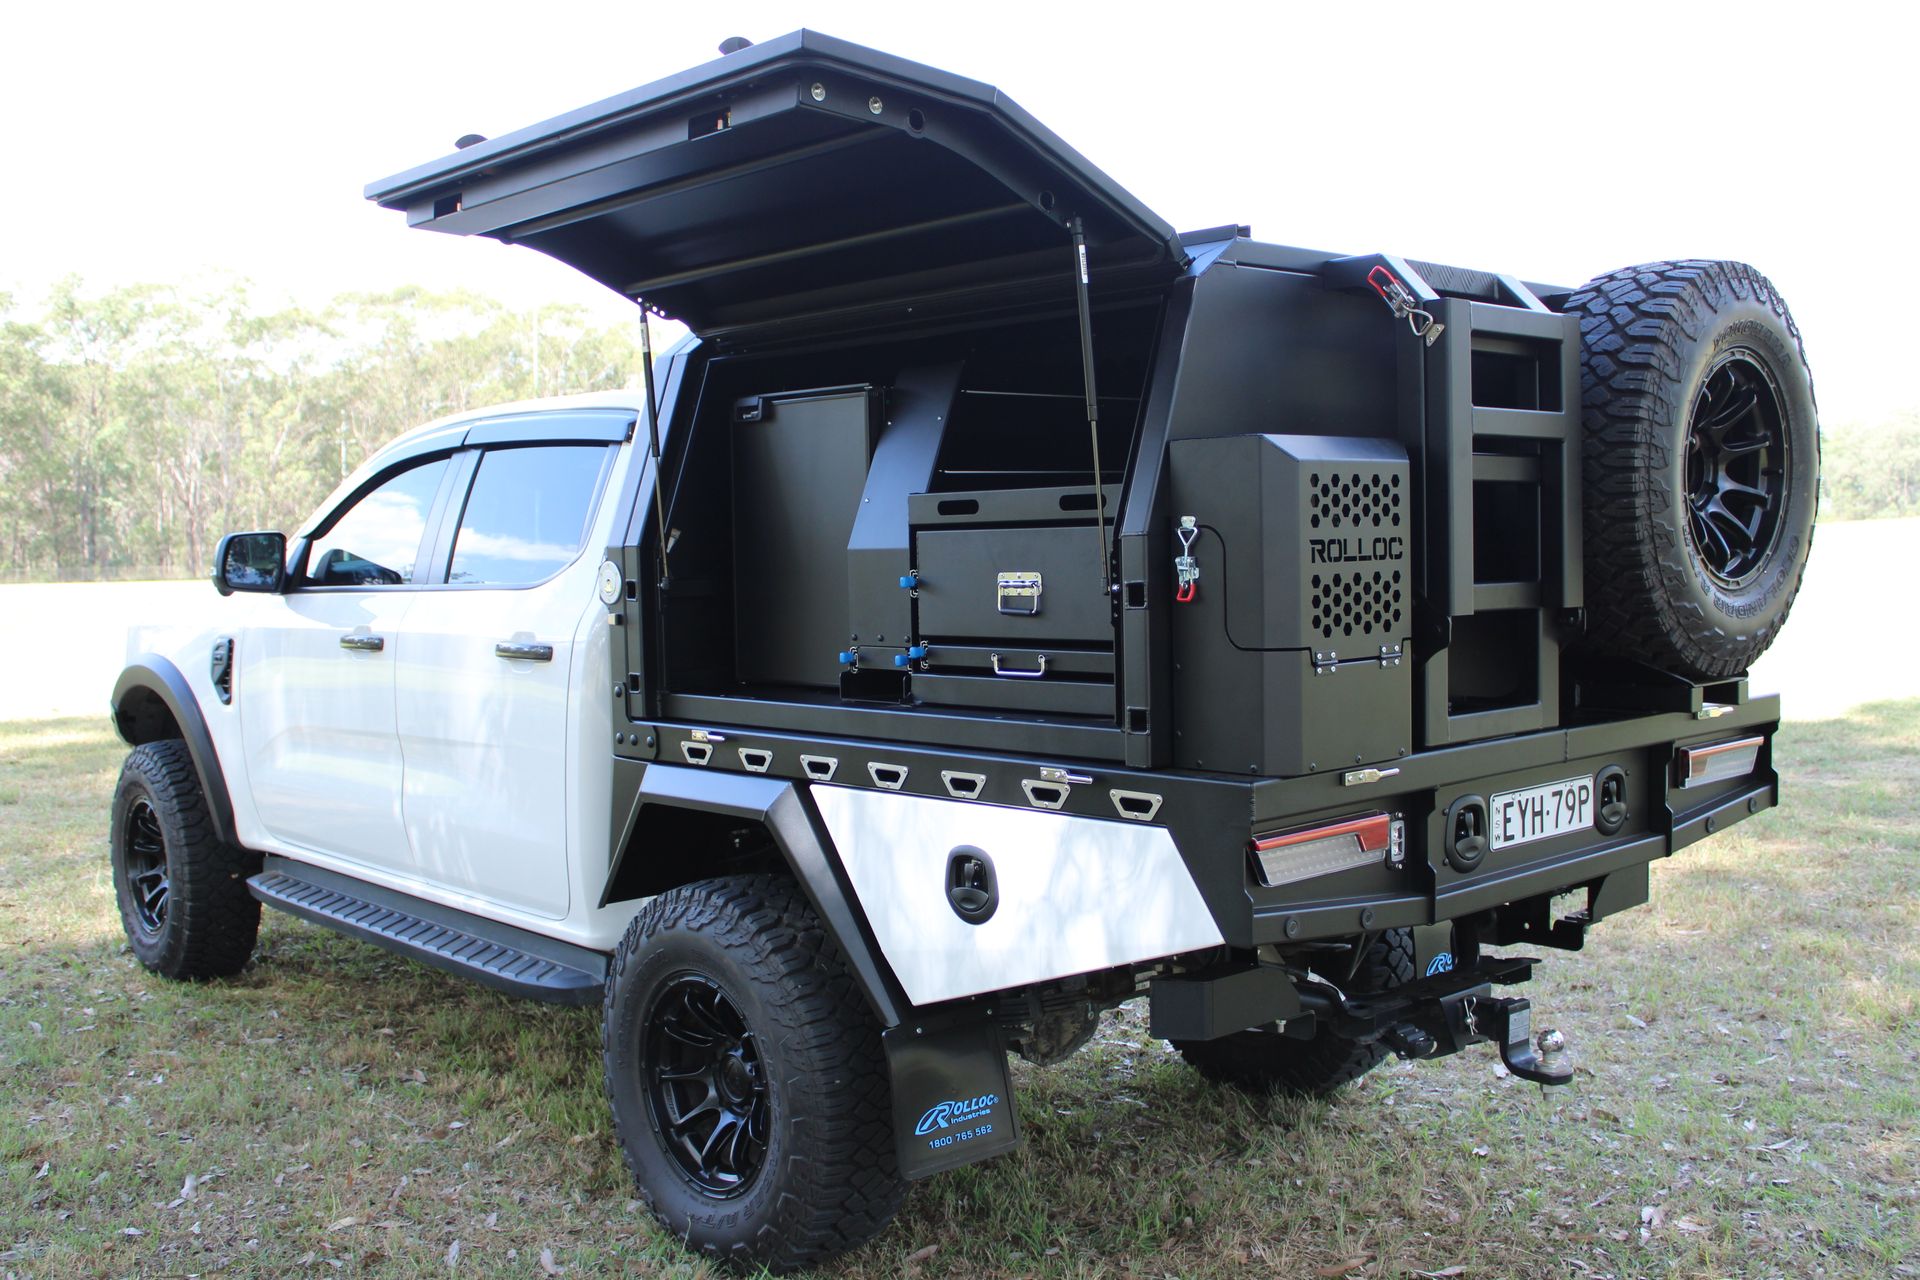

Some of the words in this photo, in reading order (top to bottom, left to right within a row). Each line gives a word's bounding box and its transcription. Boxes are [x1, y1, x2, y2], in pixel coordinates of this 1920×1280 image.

[1309, 537, 1403, 563] ROLLOC
[950, 1108, 991, 1124] Industries
[929, 1136, 953, 1149] 1800
[955, 1130, 973, 1142] 765
[976, 1124, 992, 1136] 562
